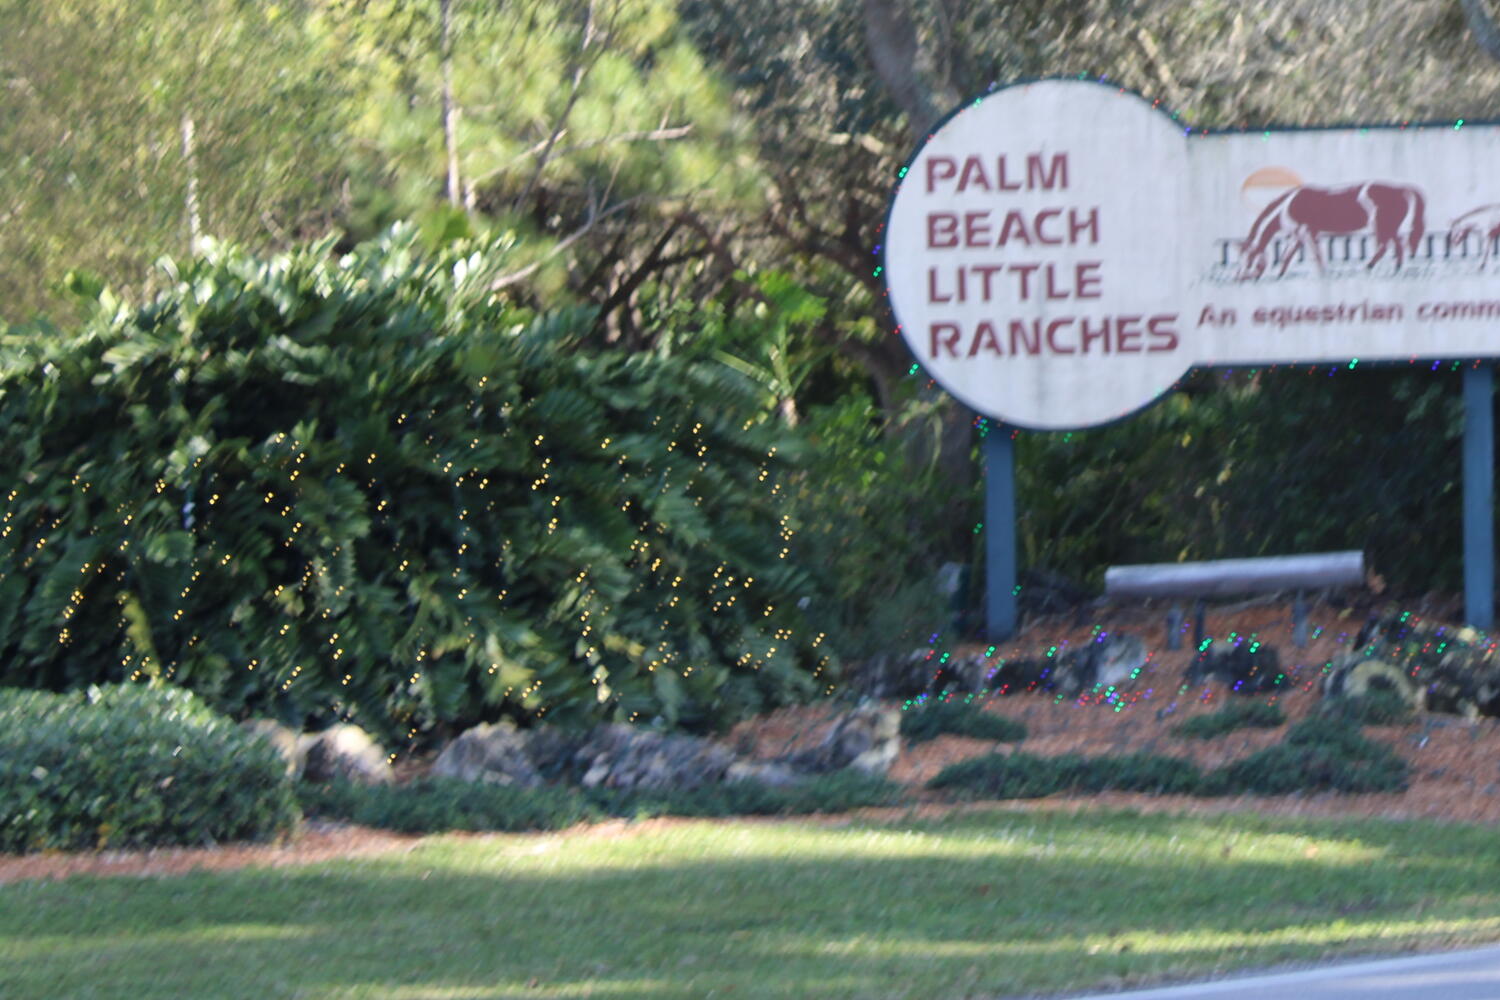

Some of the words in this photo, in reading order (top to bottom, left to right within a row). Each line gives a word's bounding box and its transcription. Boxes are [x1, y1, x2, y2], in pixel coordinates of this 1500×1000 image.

[925, 152, 1069, 194] PALM
[926, 207, 1101, 250] BEACH
[927, 261, 1103, 304] LITTLE
[1197, 302, 1236, 328] An
[1252, 299, 1403, 329] equestrian
[928, 313, 1180, 359] RANCHES
